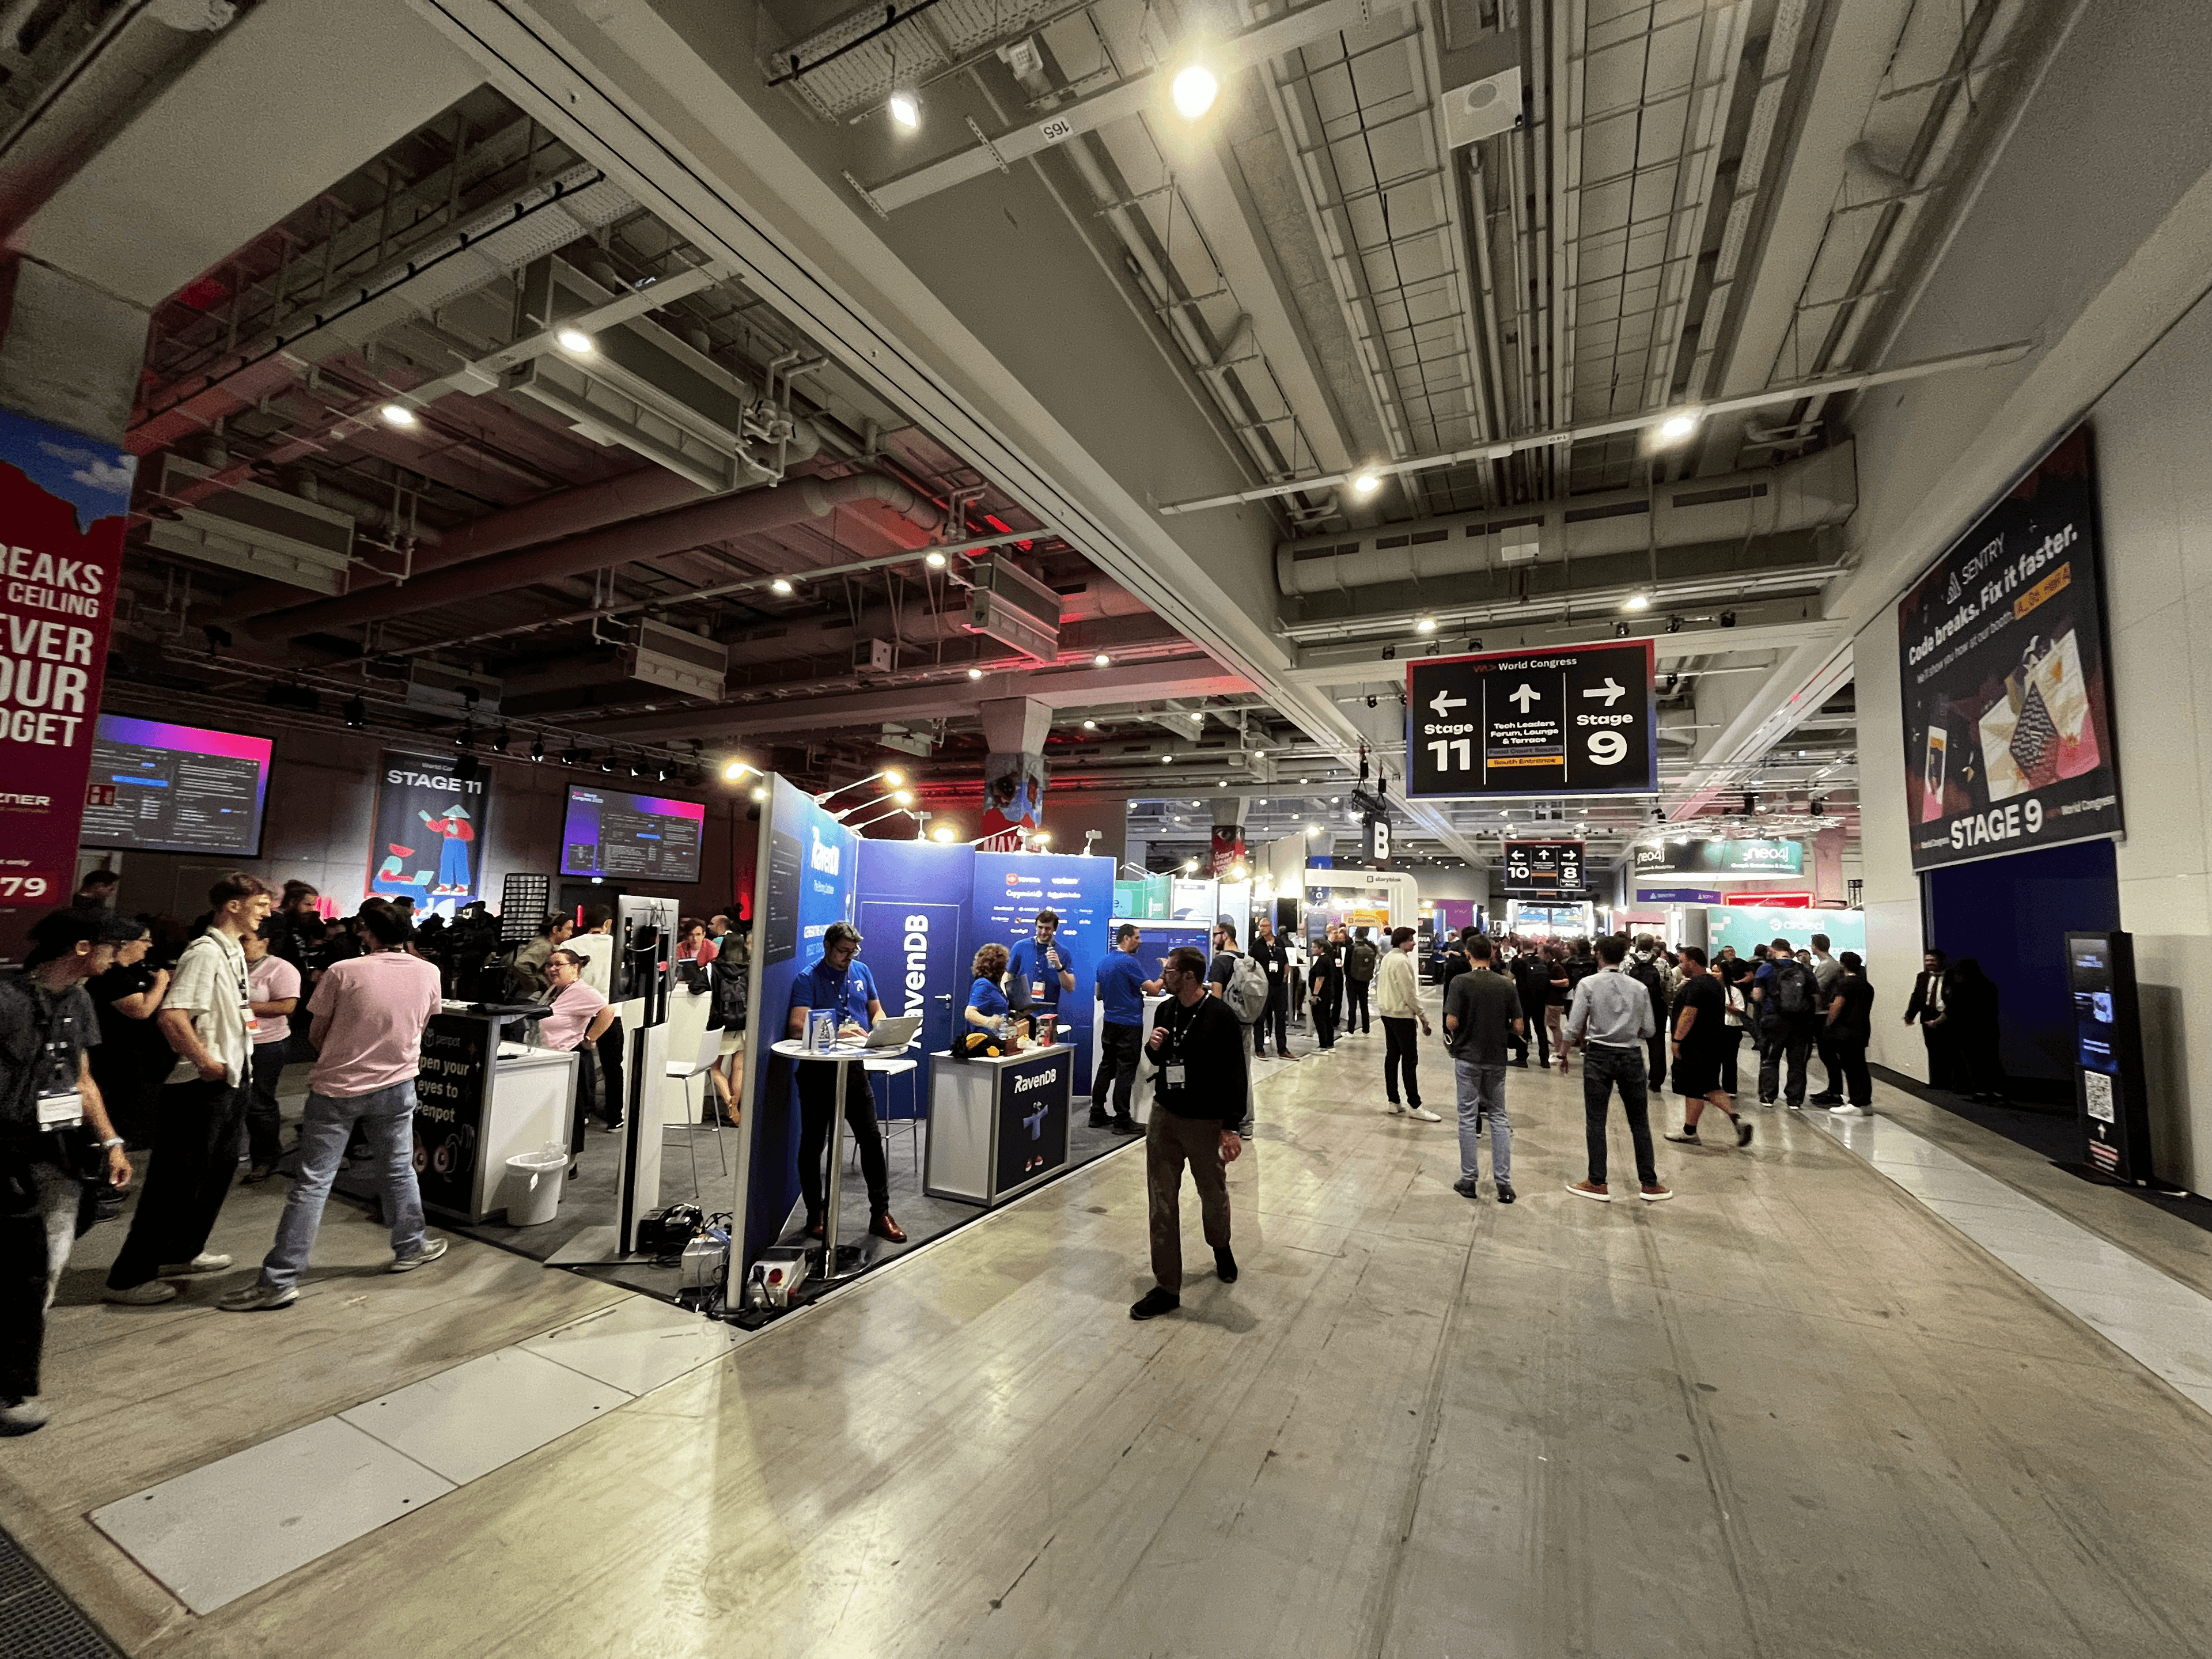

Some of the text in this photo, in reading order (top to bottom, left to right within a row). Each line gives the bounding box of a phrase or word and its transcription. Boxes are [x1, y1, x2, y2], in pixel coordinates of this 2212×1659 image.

[1043, 120, 1070, 139] 165
[1961, 532, 2005, 585] SENTRY
[7, 582, 100, 618] CEILING
[1908, 635, 1934, 665] Code
[1935, 604, 1980, 646] breaks.
[1980, 581, 2003, 611] Fix
[2004, 565, 2018, 593] it
[2018, 522, 2078, 581] faster.
[1498, 661, 1528, 671] World
[1530, 658, 1577, 669] Congress
[1424, 724, 1474, 735] Stage
[1494, 720, 1555, 730] Tech Leaders
[1576, 714, 1634, 726] Stage
[1427, 738, 1470, 771] 11
[1587, 730, 1627, 766] 9
[387, 770, 482, 794] STAGE 11
[1950, 798, 2043, 849] STAGE 9
[1374, 821, 1389, 859] B
[1747, 846, 1789, 862] neo4j
[1508, 866, 1530, 878] 10
[1563, 866, 1578, 879] 8
[0, 877, 47, 897] 79
[420, 1055, 470, 1076] pen your
[417, 1079, 459, 1099] eyes to
[1014, 1068, 1056, 1094] RavenDB
[415, 1099, 456, 1123] Penpot
